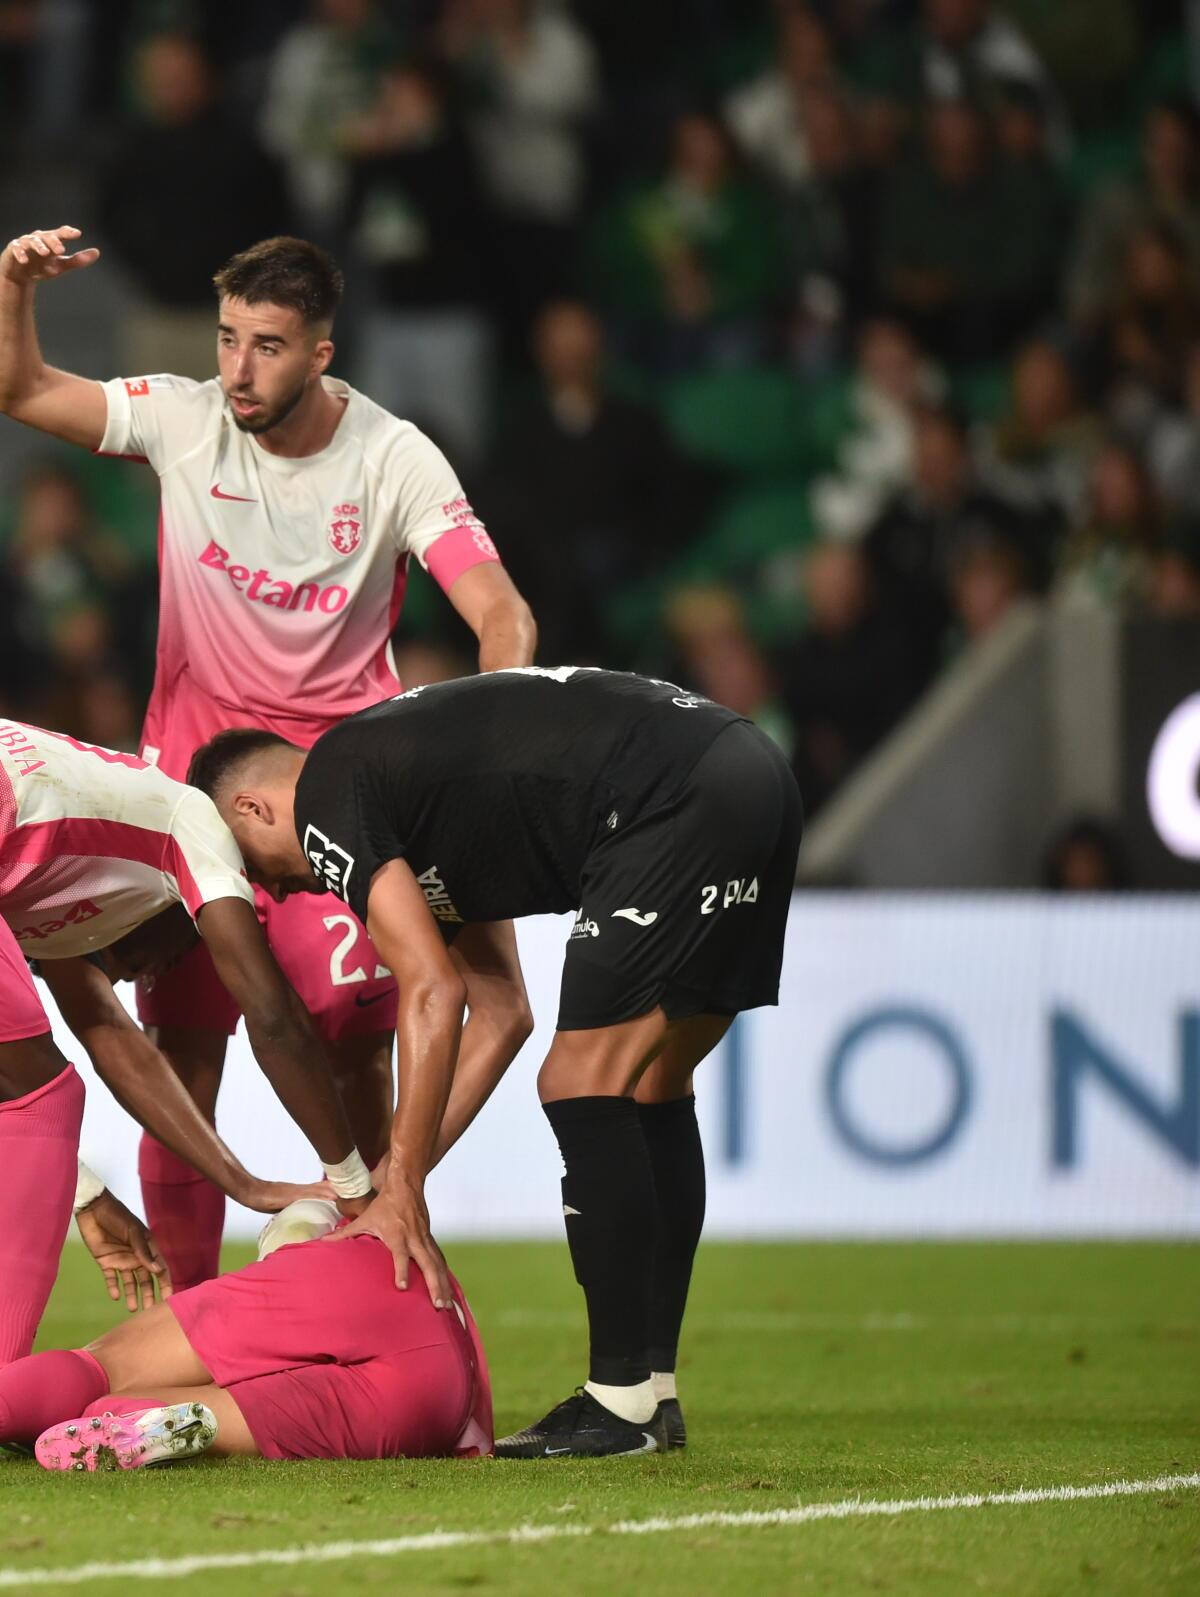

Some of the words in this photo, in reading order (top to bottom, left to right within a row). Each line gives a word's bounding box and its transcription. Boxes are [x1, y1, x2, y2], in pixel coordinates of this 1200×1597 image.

[333, 504, 359, 517] SCP
[198, 540, 349, 614] Betano
[416, 865, 464, 923] BEIRA
[700, 885, 718, 915] 2
[322, 914, 393, 987] 2
